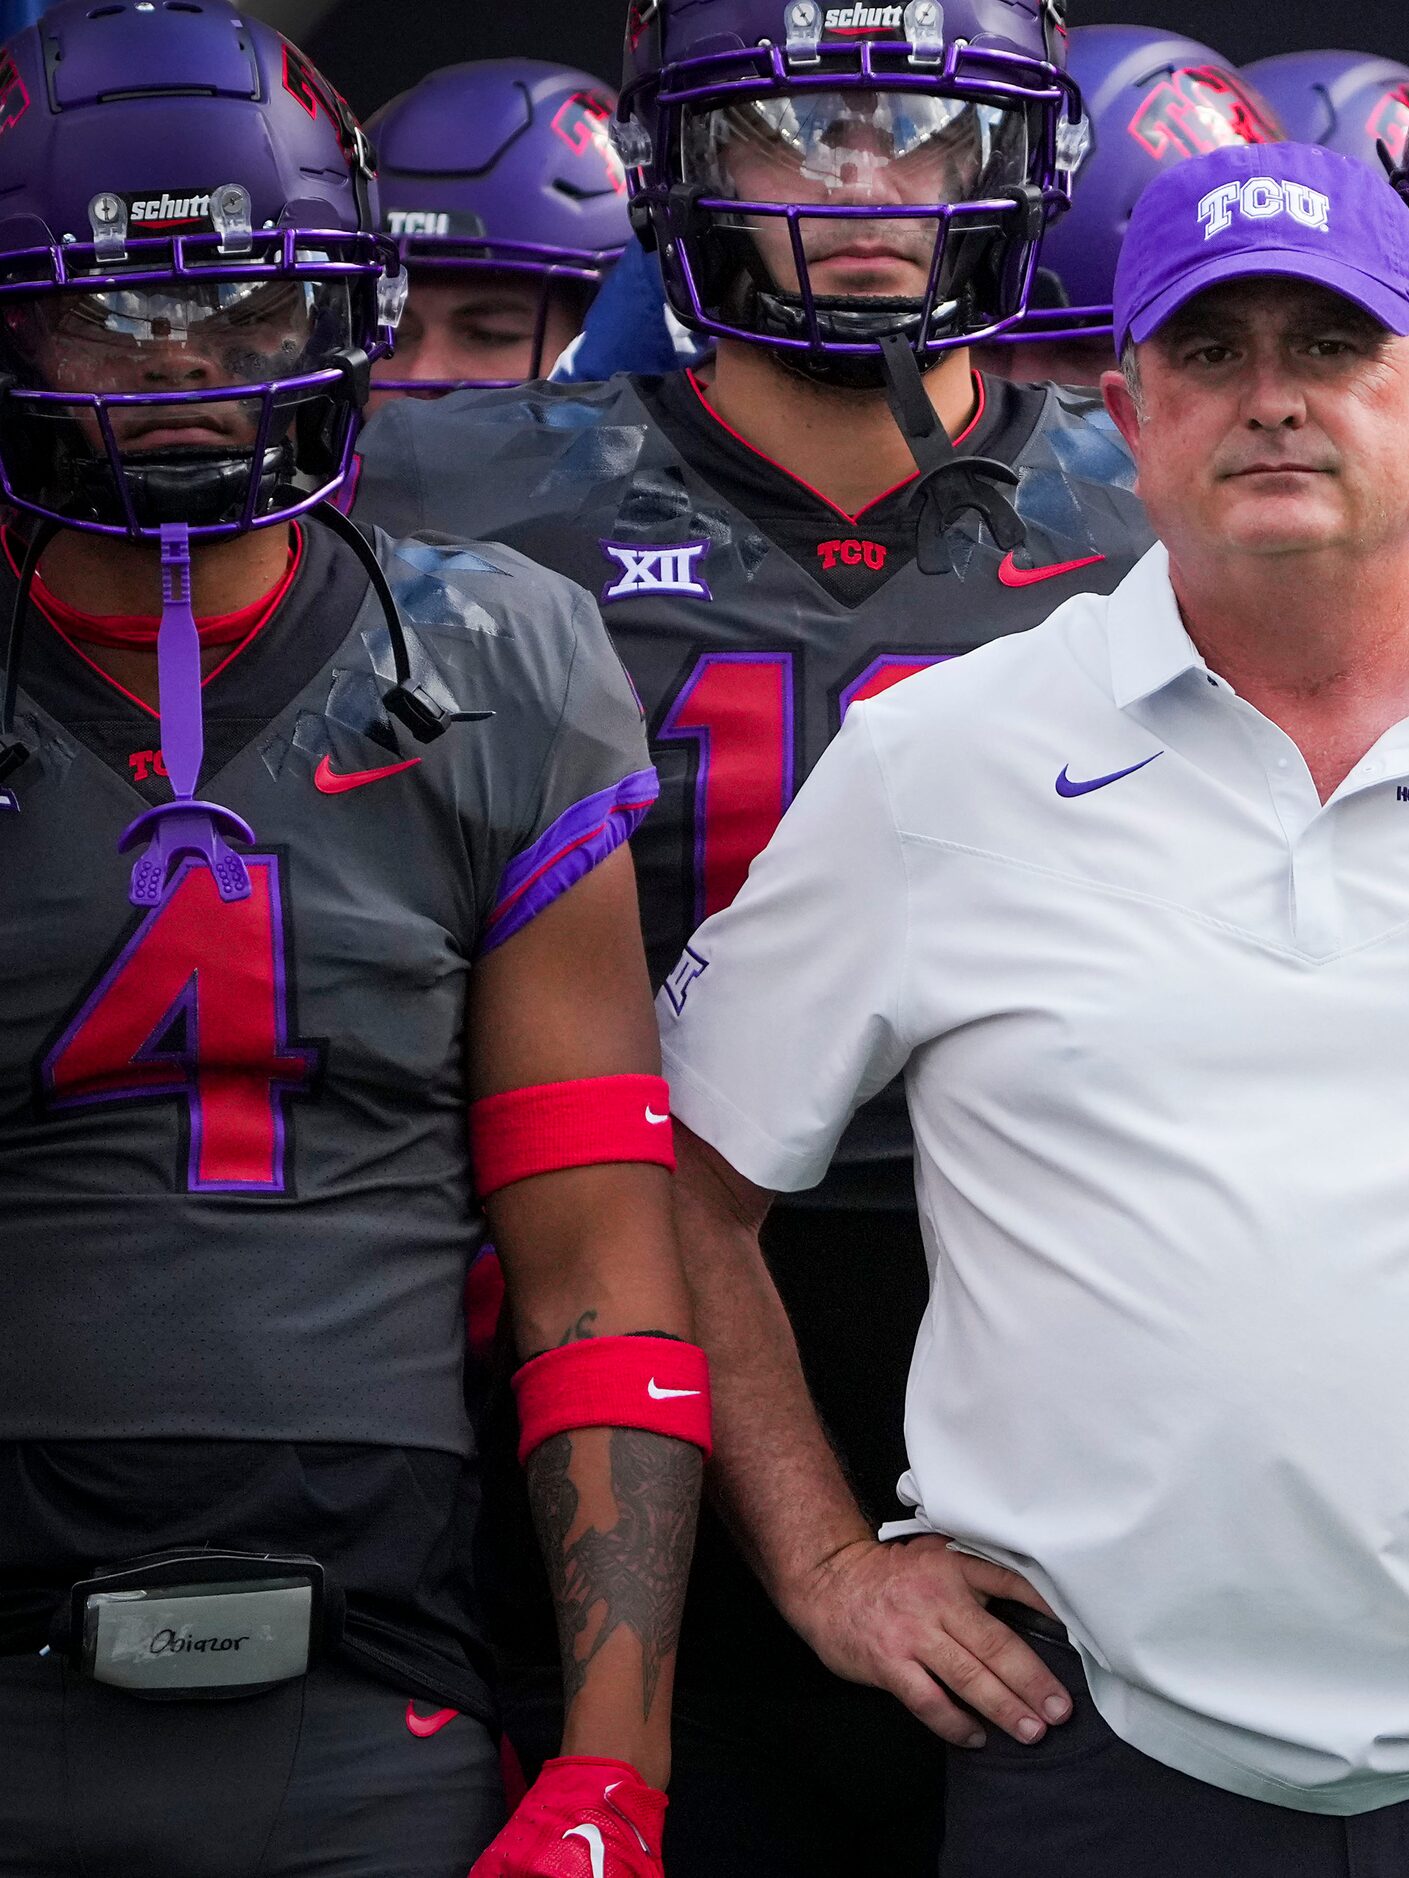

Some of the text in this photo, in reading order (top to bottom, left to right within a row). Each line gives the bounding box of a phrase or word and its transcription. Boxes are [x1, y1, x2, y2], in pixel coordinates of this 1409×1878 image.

[823, 2, 904, 28] schutt
[130, 193, 211, 221] schutt
[1197, 176, 1330, 240] TCU
[606, 544, 705, 596] XII
[817, 539, 887, 571] TCU
[41, 853, 319, 1192] 4
[150, 1628, 250, 1654] Obiazor
